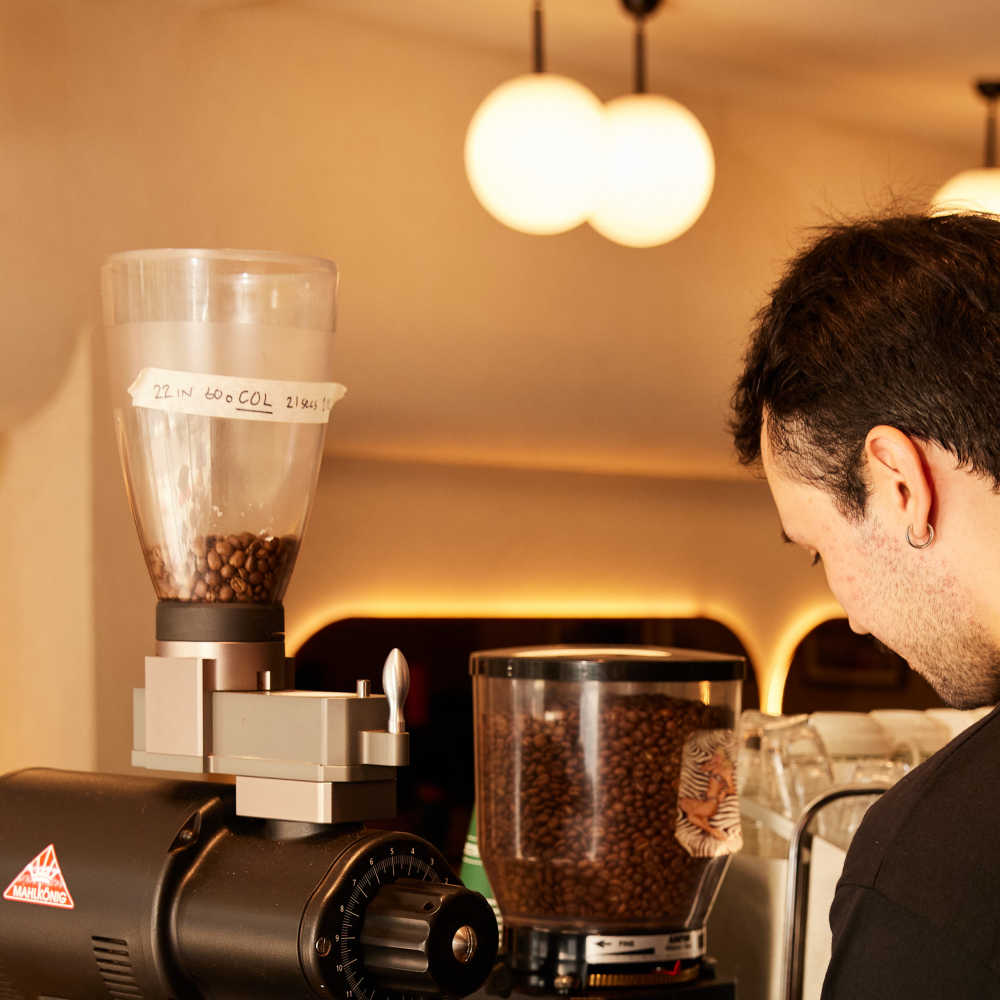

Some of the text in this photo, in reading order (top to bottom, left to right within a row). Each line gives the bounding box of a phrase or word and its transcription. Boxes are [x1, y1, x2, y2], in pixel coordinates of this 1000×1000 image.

[153, 384, 173, 399] 22
[177, 387, 193, 398] IN
[238, 390, 272, 406] COL
[12, 881, 67, 904] MAHLKÖNIG
[346, 990, 353, 998] 11
